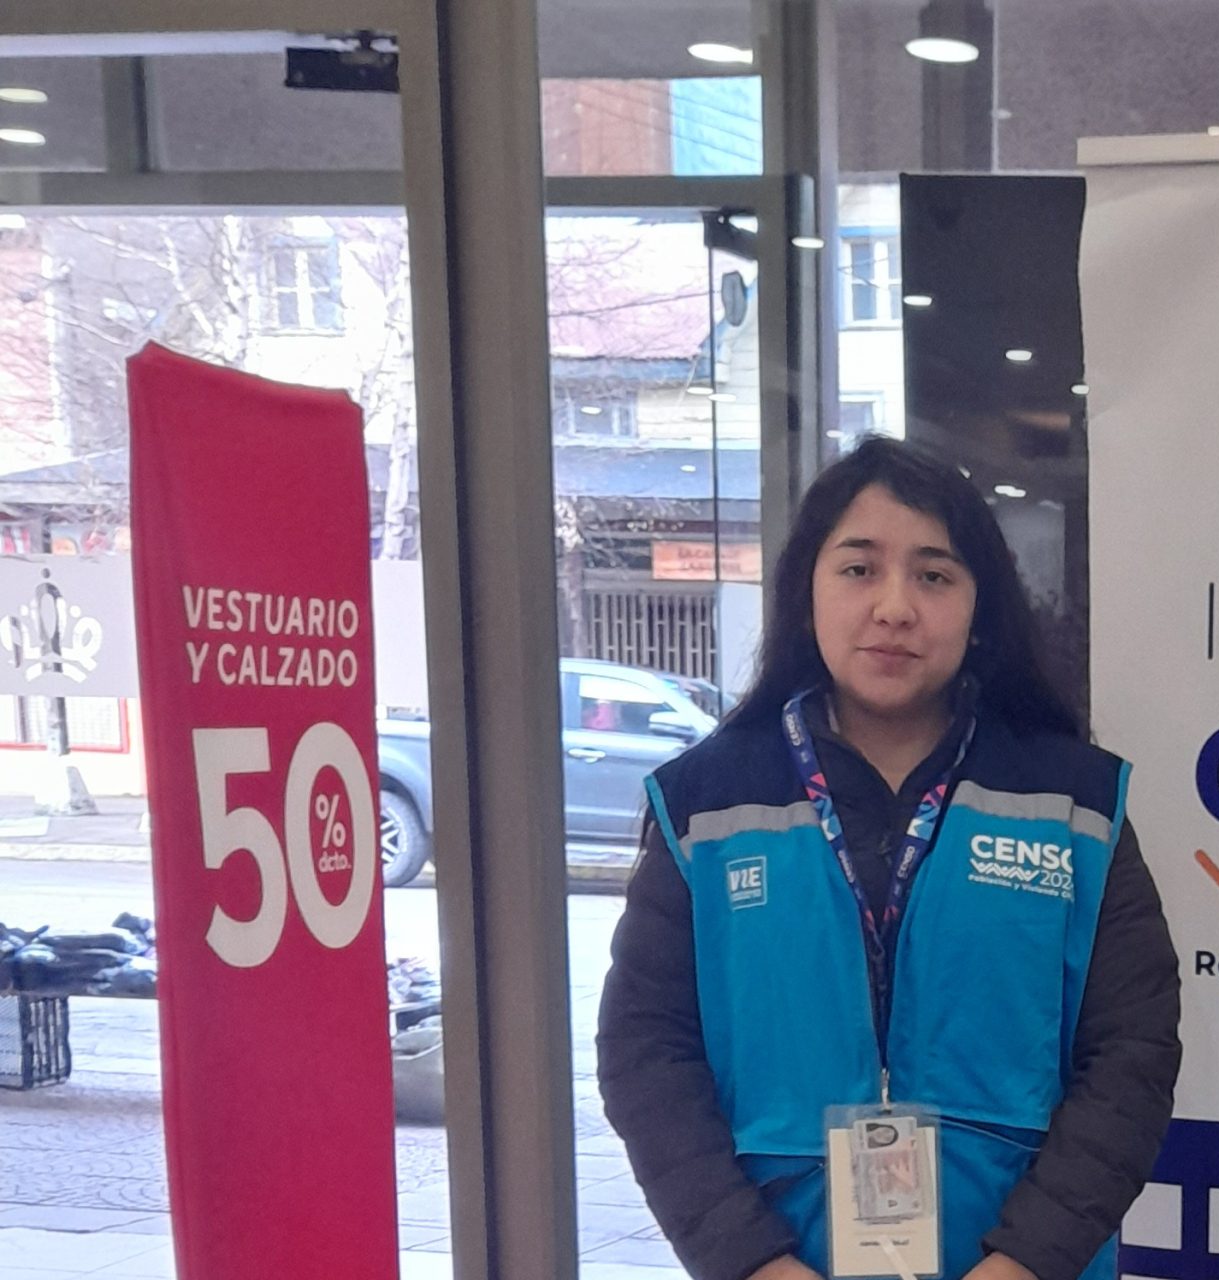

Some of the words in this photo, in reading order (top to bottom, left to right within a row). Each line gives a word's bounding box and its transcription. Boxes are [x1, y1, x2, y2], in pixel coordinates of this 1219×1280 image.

[183, 585, 359, 638] VESTUARIO
[186, 641, 209, 684] Y
[217, 643, 358, 687] CALZADO
[192, 721, 377, 969] 50
[315, 794, 346, 848] %
[318, 851, 352, 873] dcto.
[1040, 870, 1074, 890] 202
